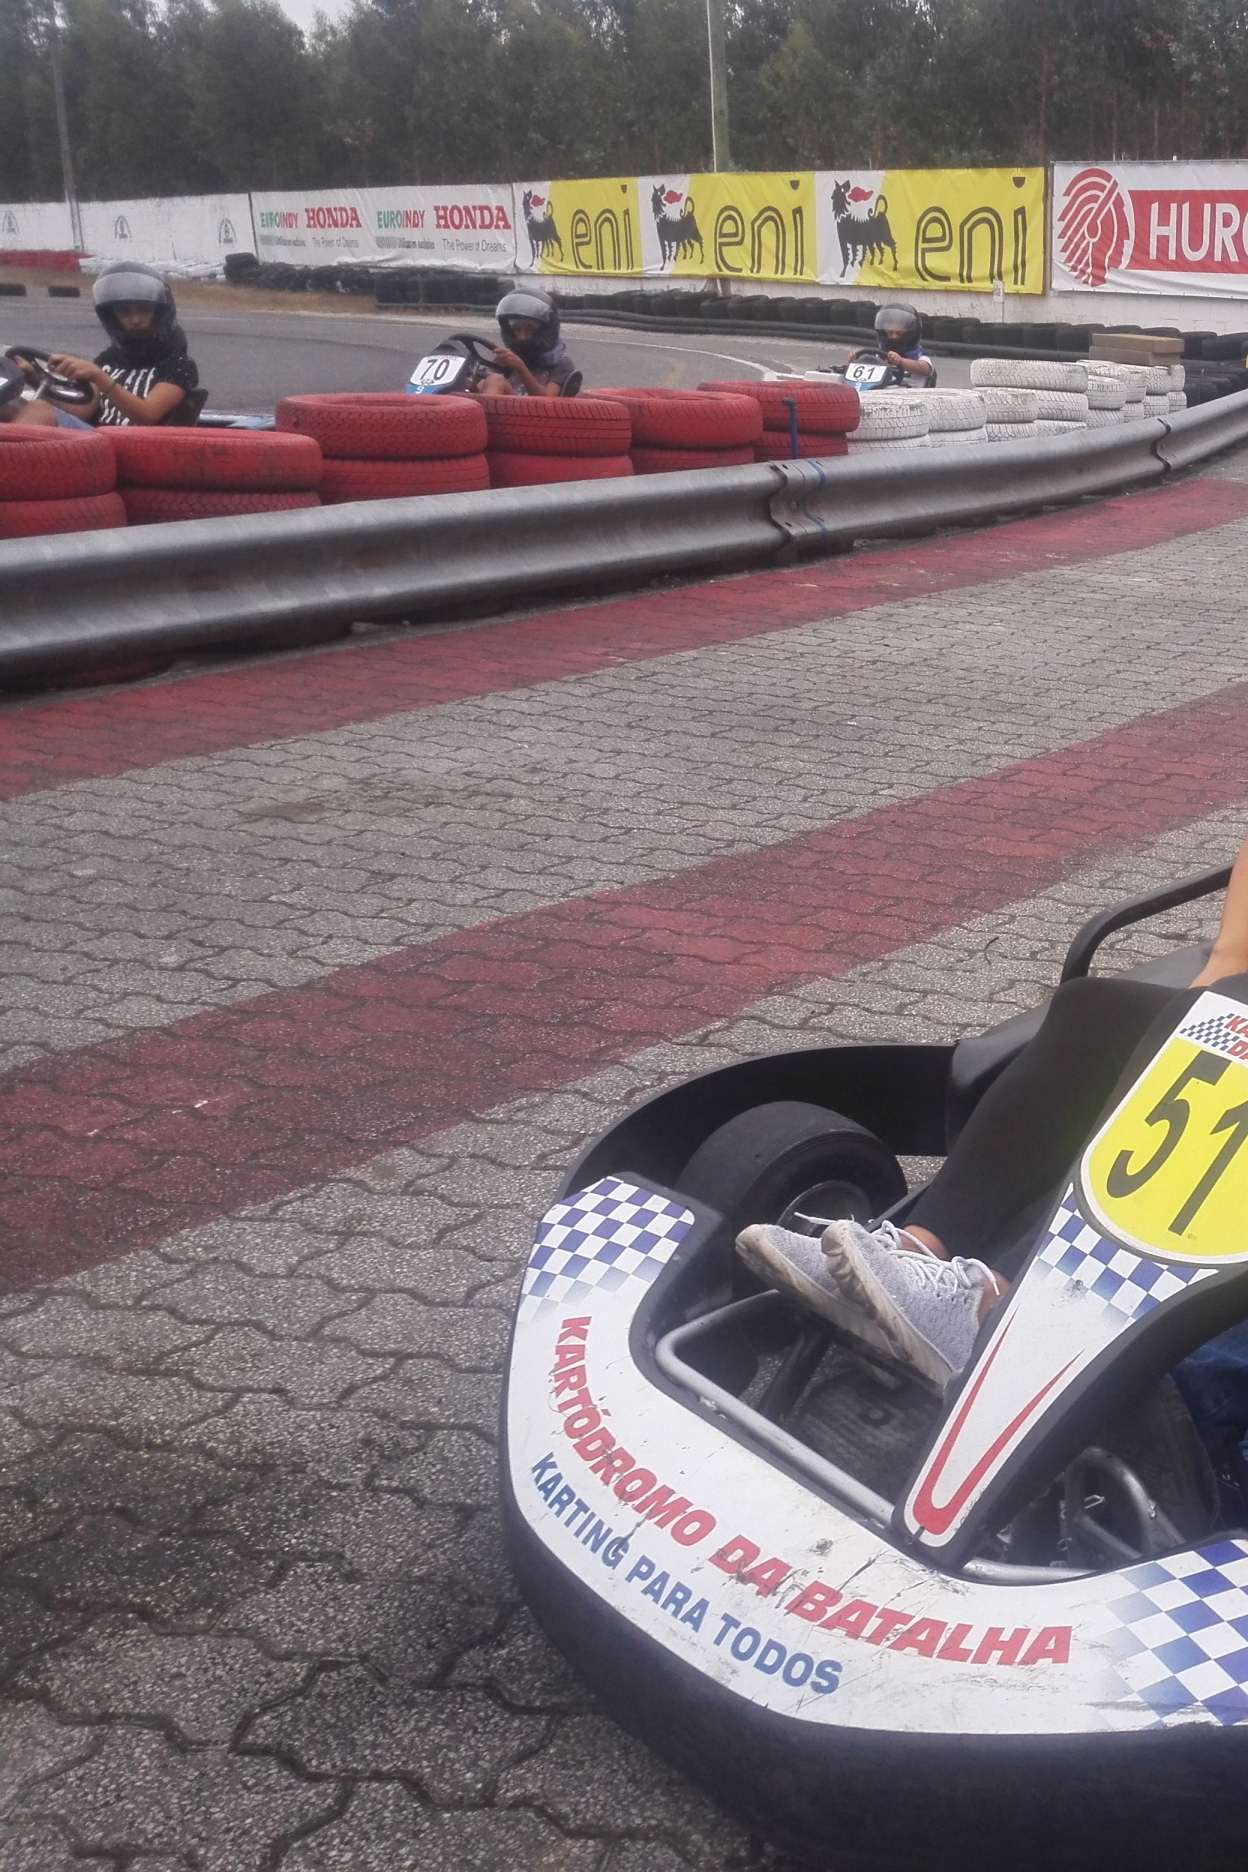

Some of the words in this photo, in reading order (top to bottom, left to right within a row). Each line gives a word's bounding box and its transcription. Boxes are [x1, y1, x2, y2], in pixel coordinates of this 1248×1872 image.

[304, 206, 362, 229] HONDA
[376, 209, 425, 229] EUROINDY
[433, 204, 512, 230] HONDA
[571, 184, 634, 271] eni
[714, 179, 805, 276] eni
[914, 176, 1027, 287] eni
[420, 358, 450, 381] 70
[852, 365, 876, 380] 61
[551, 1315, 717, 1547] KARTÓDROMO
[708, 1534, 793, 1598] DA
[785, 1580, 1074, 1667] BATALHA
[531, 1451, 630, 1569] KARTING
[624, 1554, 710, 1634] PARA
[711, 1612, 844, 1695] TODOS
